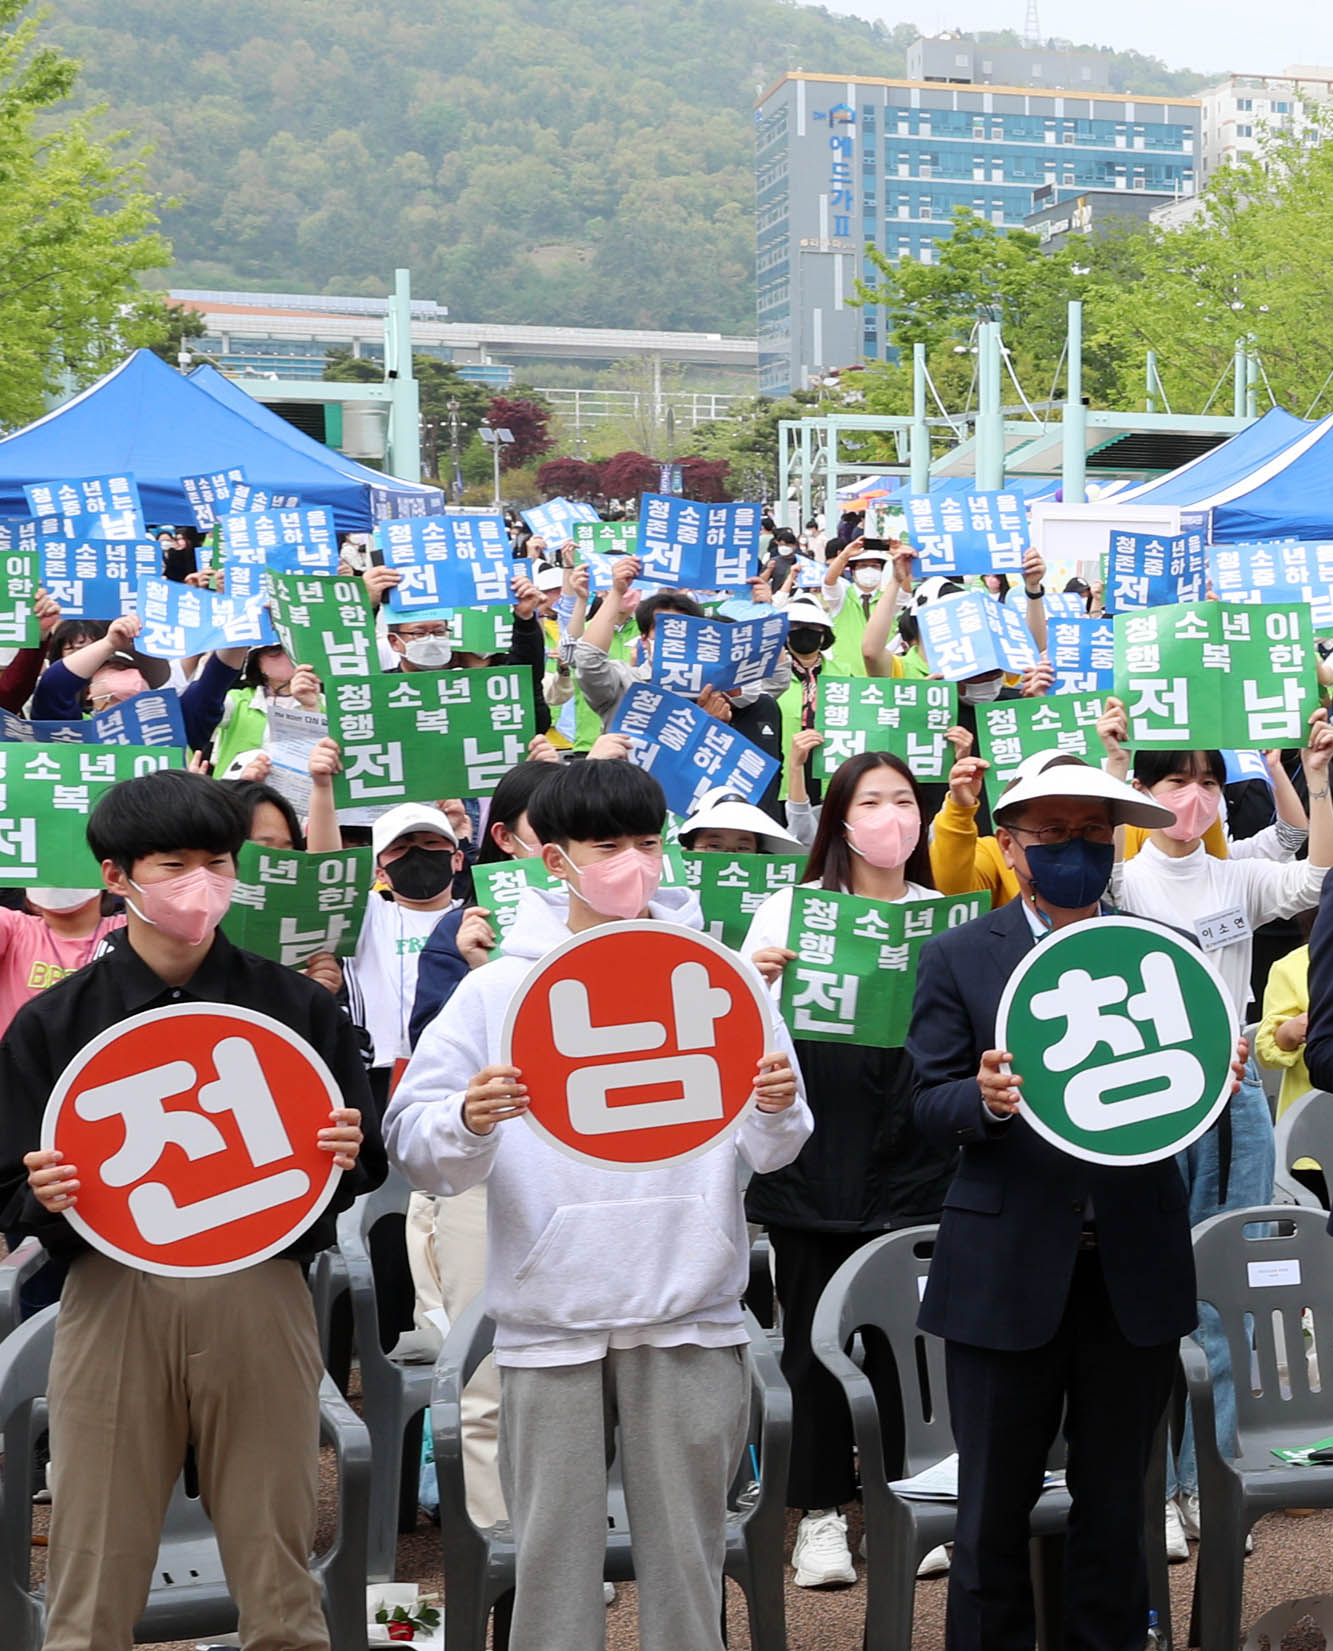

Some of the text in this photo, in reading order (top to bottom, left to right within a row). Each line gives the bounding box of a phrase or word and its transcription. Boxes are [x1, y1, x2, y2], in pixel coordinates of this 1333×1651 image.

[31, 477, 129, 504] 청소년을
[909, 494, 1019, 516] 청소년을
[228, 510, 327, 534] 청소년을
[647, 499, 755, 526] 청소년을
[912, 512, 1022, 534] 존중하는
[230, 527, 329, 548] 존중하는
[387, 519, 502, 544] 청소년을
[577, 525, 637, 541] 청소년
[645, 518, 753, 547] 존중하는
[1115, 534, 1202, 558] 청소년을
[45, 541, 156, 562] 청소년을
[391, 539, 506, 565] 존중하는
[643, 540, 752, 587] 전남
[918, 531, 1026, 573] 전남
[1114, 550, 1202, 577] 존중하는
[45, 560, 157, 579] 존중하는
[397, 560, 512, 607] 전남
[1113, 573, 1202, 612] 전남
[143, 606, 263, 656] 전남
[663, 617, 783, 645] 청소년을
[1124, 610, 1300, 643] 청소년이
[661, 633, 780, 664] 존중하는
[934, 636, 1038, 677] 전남
[1125, 643, 1305, 674] 행복한
[660, 650, 772, 701] 전남
[338, 674, 519, 712] 청소년이
[825, 682, 950, 707] 청소년이
[1128, 677, 1307, 742] 전남
[339, 703, 525, 741] 행복한
[634, 689, 767, 777] 청소년을
[824, 705, 952, 730] 행복한
[986, 698, 1102, 737] 청소년
[621, 713, 753, 796] 존중하는
[822, 729, 947, 778] 전남
[989, 729, 1089, 765] 행복
[343, 734, 525, 799] 전남
[686, 861, 797, 889] 청소년
[802, 897, 979, 941] 청소년이
[1202, 917, 1246, 938] 이소연
[797, 931, 911, 972] 행복
[549, 962, 733, 1136] 남
[1030, 951, 1206, 1133] 청
[75, 1036, 311, 1246] 전
